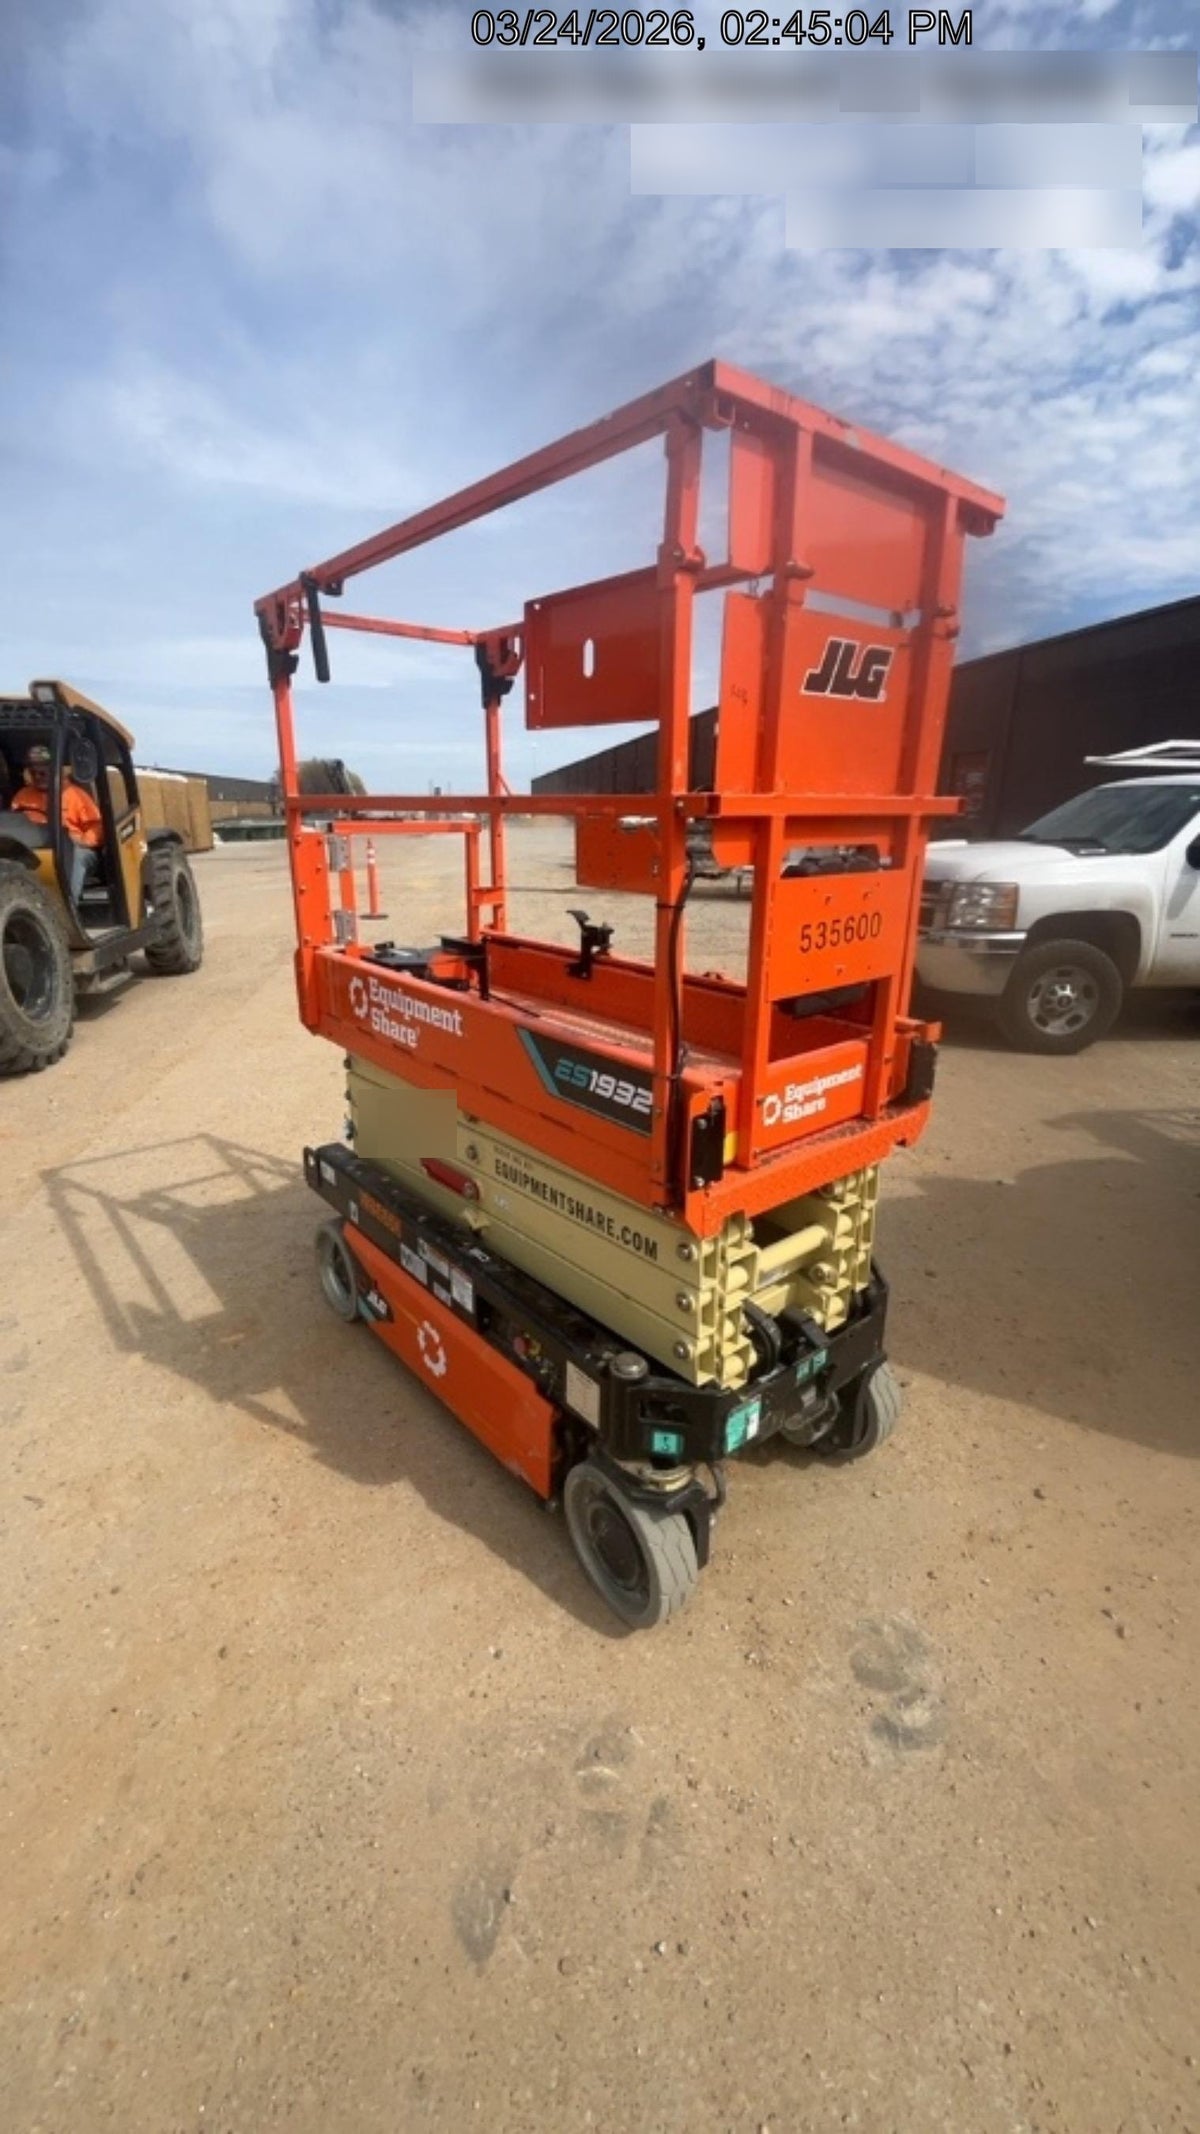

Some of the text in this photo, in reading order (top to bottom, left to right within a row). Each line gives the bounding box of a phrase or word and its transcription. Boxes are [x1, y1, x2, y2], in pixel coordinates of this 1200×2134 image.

[801, 637, 894, 702] JLG
[800, 912, 882, 954] 535600
[369, 976, 463, 1037] Equipment
[555, 1058, 654, 1113] ES1932
[782, 1095, 827, 1123] Share
[784, 1064, 863, 1102] Equipment
[495, 1159, 658, 1261] EQUIPMENTSHARE.COM
